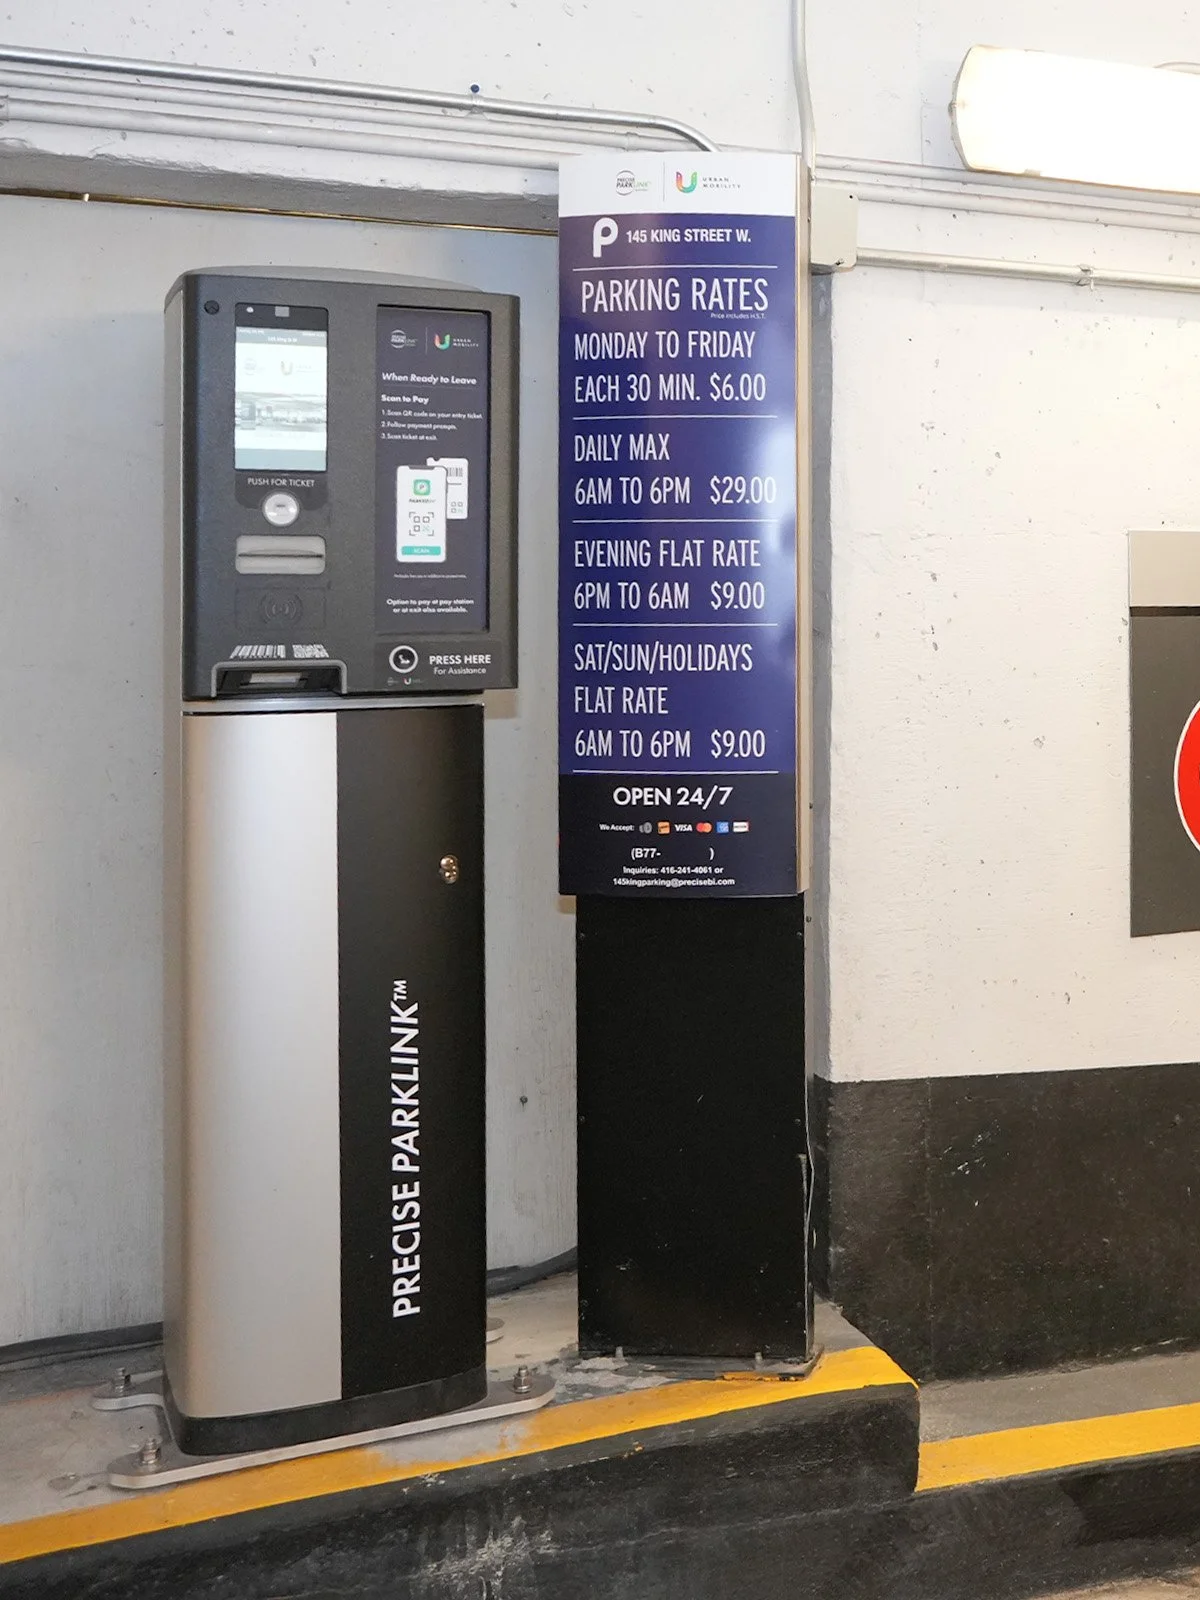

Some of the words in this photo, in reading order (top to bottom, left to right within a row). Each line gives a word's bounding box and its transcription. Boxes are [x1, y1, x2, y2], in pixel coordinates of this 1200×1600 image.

[626, 230, 648, 243] 145
[651, 229, 681, 242] KING
[684, 228, 732, 242] STREET
[736, 228, 751, 242] W.
[581, 278, 680, 313] PARKING
[691, 278, 769, 312] RATES
[575, 331, 648, 360] MONDAY
[655, 331, 679, 359] TO
[687, 330, 756, 359] FRIDAY
[382, 372, 409, 381] When
[410, 373, 439, 385] Ready
[440, 376, 450, 384] to
[451, 375, 477, 385] Leave
[575, 374, 620, 403] EACH
[626, 373, 650, 402] 30
[658, 373, 701, 402] MIN.
[709, 372, 766, 402] $6.00
[381, 394, 402, 402] Scan
[402, 395, 412, 403] to
[412, 395, 430, 406] Pay
[402, 409, 413, 417] QR
[407, 422, 433, 430] payment
[574, 434, 622, 462] DAILY
[629, 433, 670, 461] MAX
[247, 477, 270, 486] PUSH
[270, 478, 288, 487] FOR
[289, 479, 315, 488] TICKET
[574, 477, 613, 505] 6AM
[619, 477, 642, 504] TO
[650, 476, 691, 504] 6PM
[709, 475, 777, 505] $29.00
[574, 540, 651, 568] EVENING
[659, 540, 705, 567] FLAT
[712, 539, 761, 567] RATE
[386, 598, 409, 606] Option
[574, 582, 610, 610] 6PM
[617, 582, 641, 609] TO
[648, 582, 690, 609] 6AM
[710, 580, 765, 610] $9.00
[429, 654, 462, 665] PRESS
[464, 654, 492, 664] HERE
[573, 641, 753, 674] SAT/SUN/HOLIDAYS
[433, 666, 446, 675] For
[447, 666, 487, 675] Assistance
[574, 686, 615, 714] FLAT
[622, 686, 668, 714] RATE
[574, 730, 612, 757] 6AM
[619, 730, 643, 757] TO
[650, 730, 691, 757] 6PM
[710, 729, 766, 758] $9.00
[612, 787, 672, 806] OPEN
[676, 785, 734, 810] 24/7
[599, 823, 610, 831] We
[610, 824, 635, 832] Accept:
[674, 824, 693, 832] VISA
[631, 847, 662, 861] (B77-
[622, 866, 659, 875] Inquiries:
[660, 866, 712, 874] 416-241-4061
[391, 1181, 420, 1319] PRECISE
